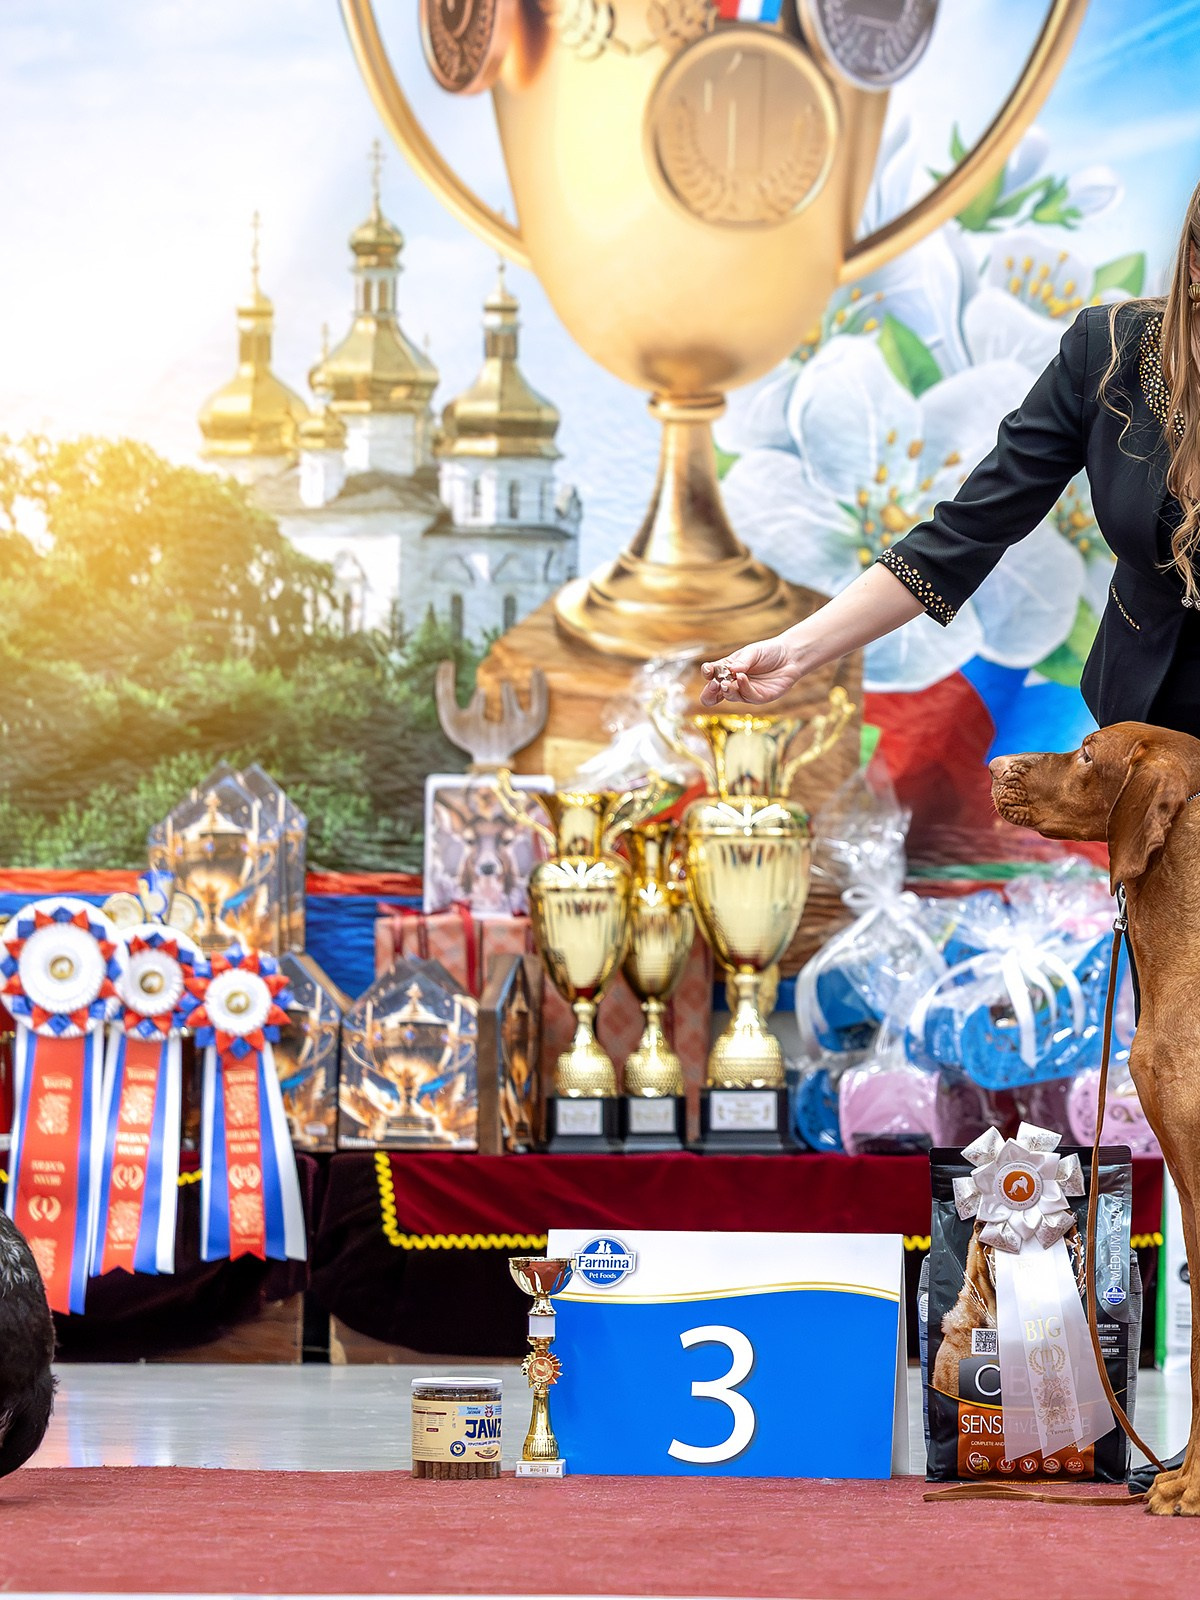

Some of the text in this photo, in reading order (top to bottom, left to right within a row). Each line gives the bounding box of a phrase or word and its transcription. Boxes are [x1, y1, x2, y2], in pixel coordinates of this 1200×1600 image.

[577, 1255, 630, 1269] Farmina
[1109, 1235, 1122, 1281] MEDIUM
[1023, 1315, 1062, 1342] BIG
[666, 1324, 756, 1465] 3
